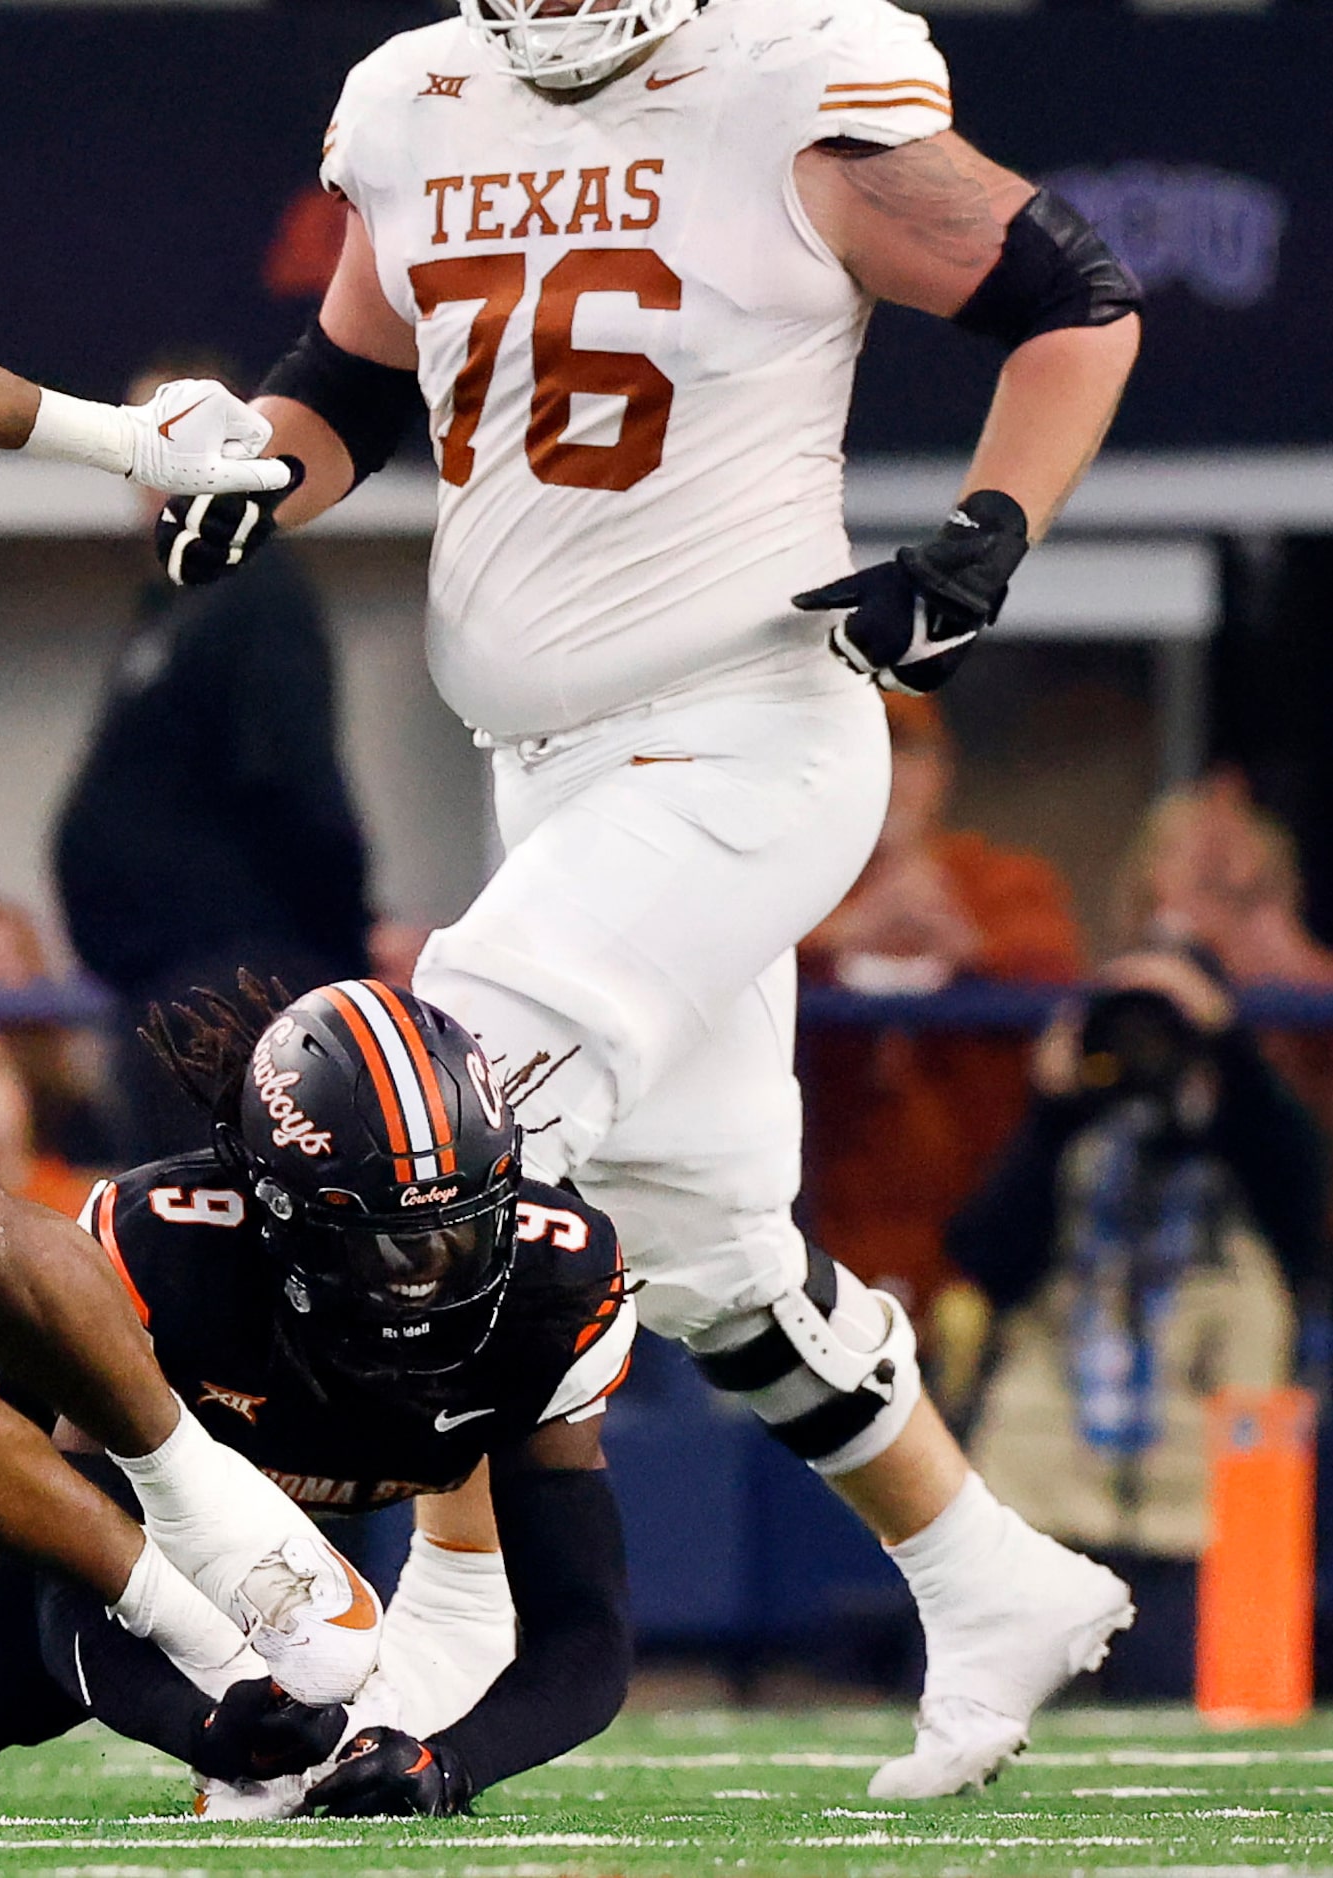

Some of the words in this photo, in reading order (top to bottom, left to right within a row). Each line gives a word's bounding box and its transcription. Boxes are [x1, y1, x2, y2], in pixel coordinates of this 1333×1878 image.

[425, 159, 664, 244] TEXAS
[407, 248, 682, 491] 76
[253, 1015, 333, 1156] Cowboys
[148, 1186, 246, 1228] 9
[400, 1186, 460, 1207] Cowboys
